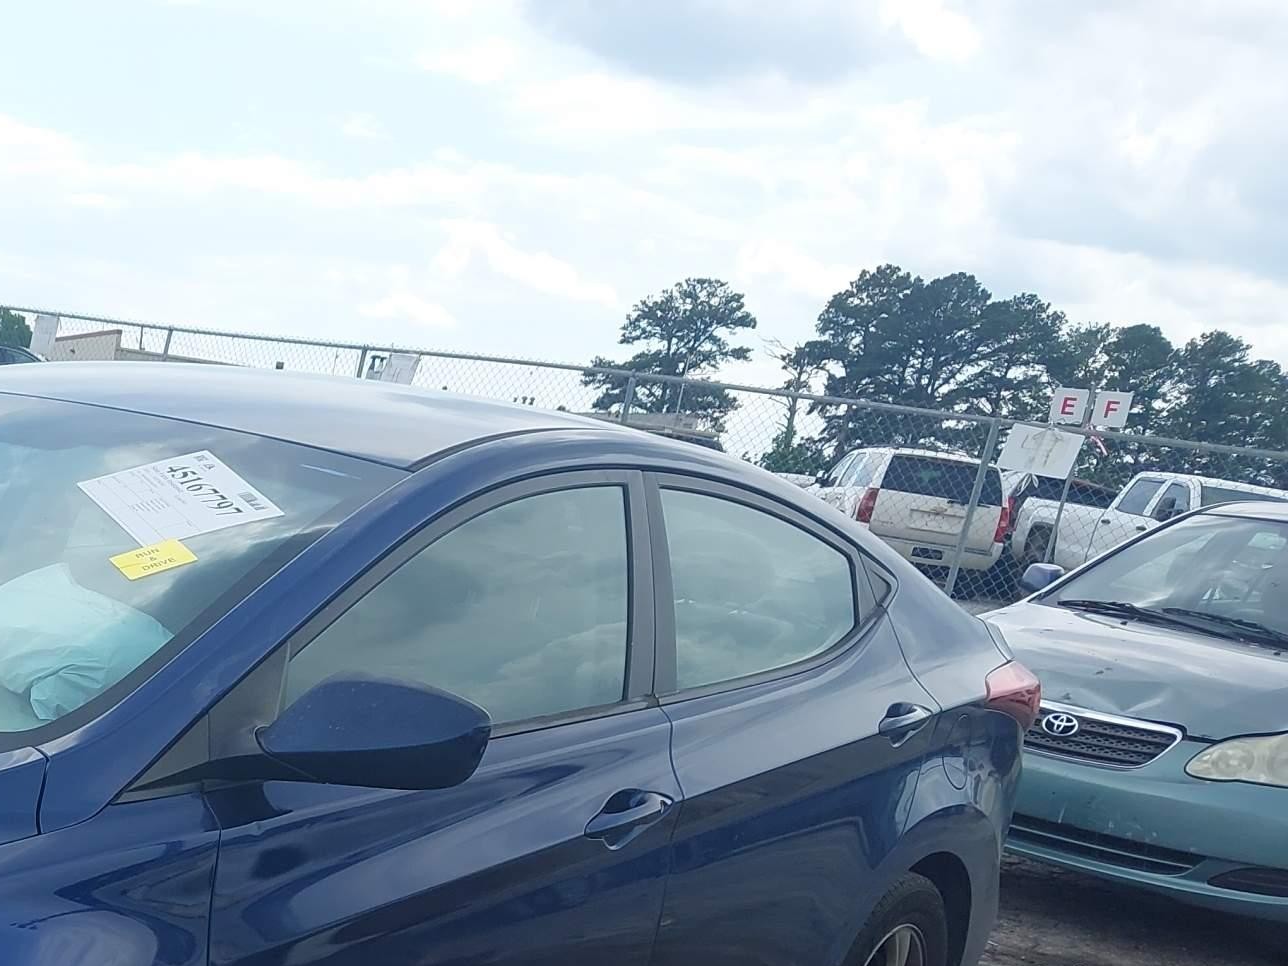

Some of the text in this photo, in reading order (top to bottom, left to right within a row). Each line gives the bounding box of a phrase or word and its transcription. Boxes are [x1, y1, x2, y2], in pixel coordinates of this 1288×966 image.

[1061, 397, 1077, 415] E
[1105, 401, 1120, 418] F
[166, 465, 243, 515] 45167797
[135, 548, 160, 559] RUN
[141, 557, 177, 571] DRIVE
